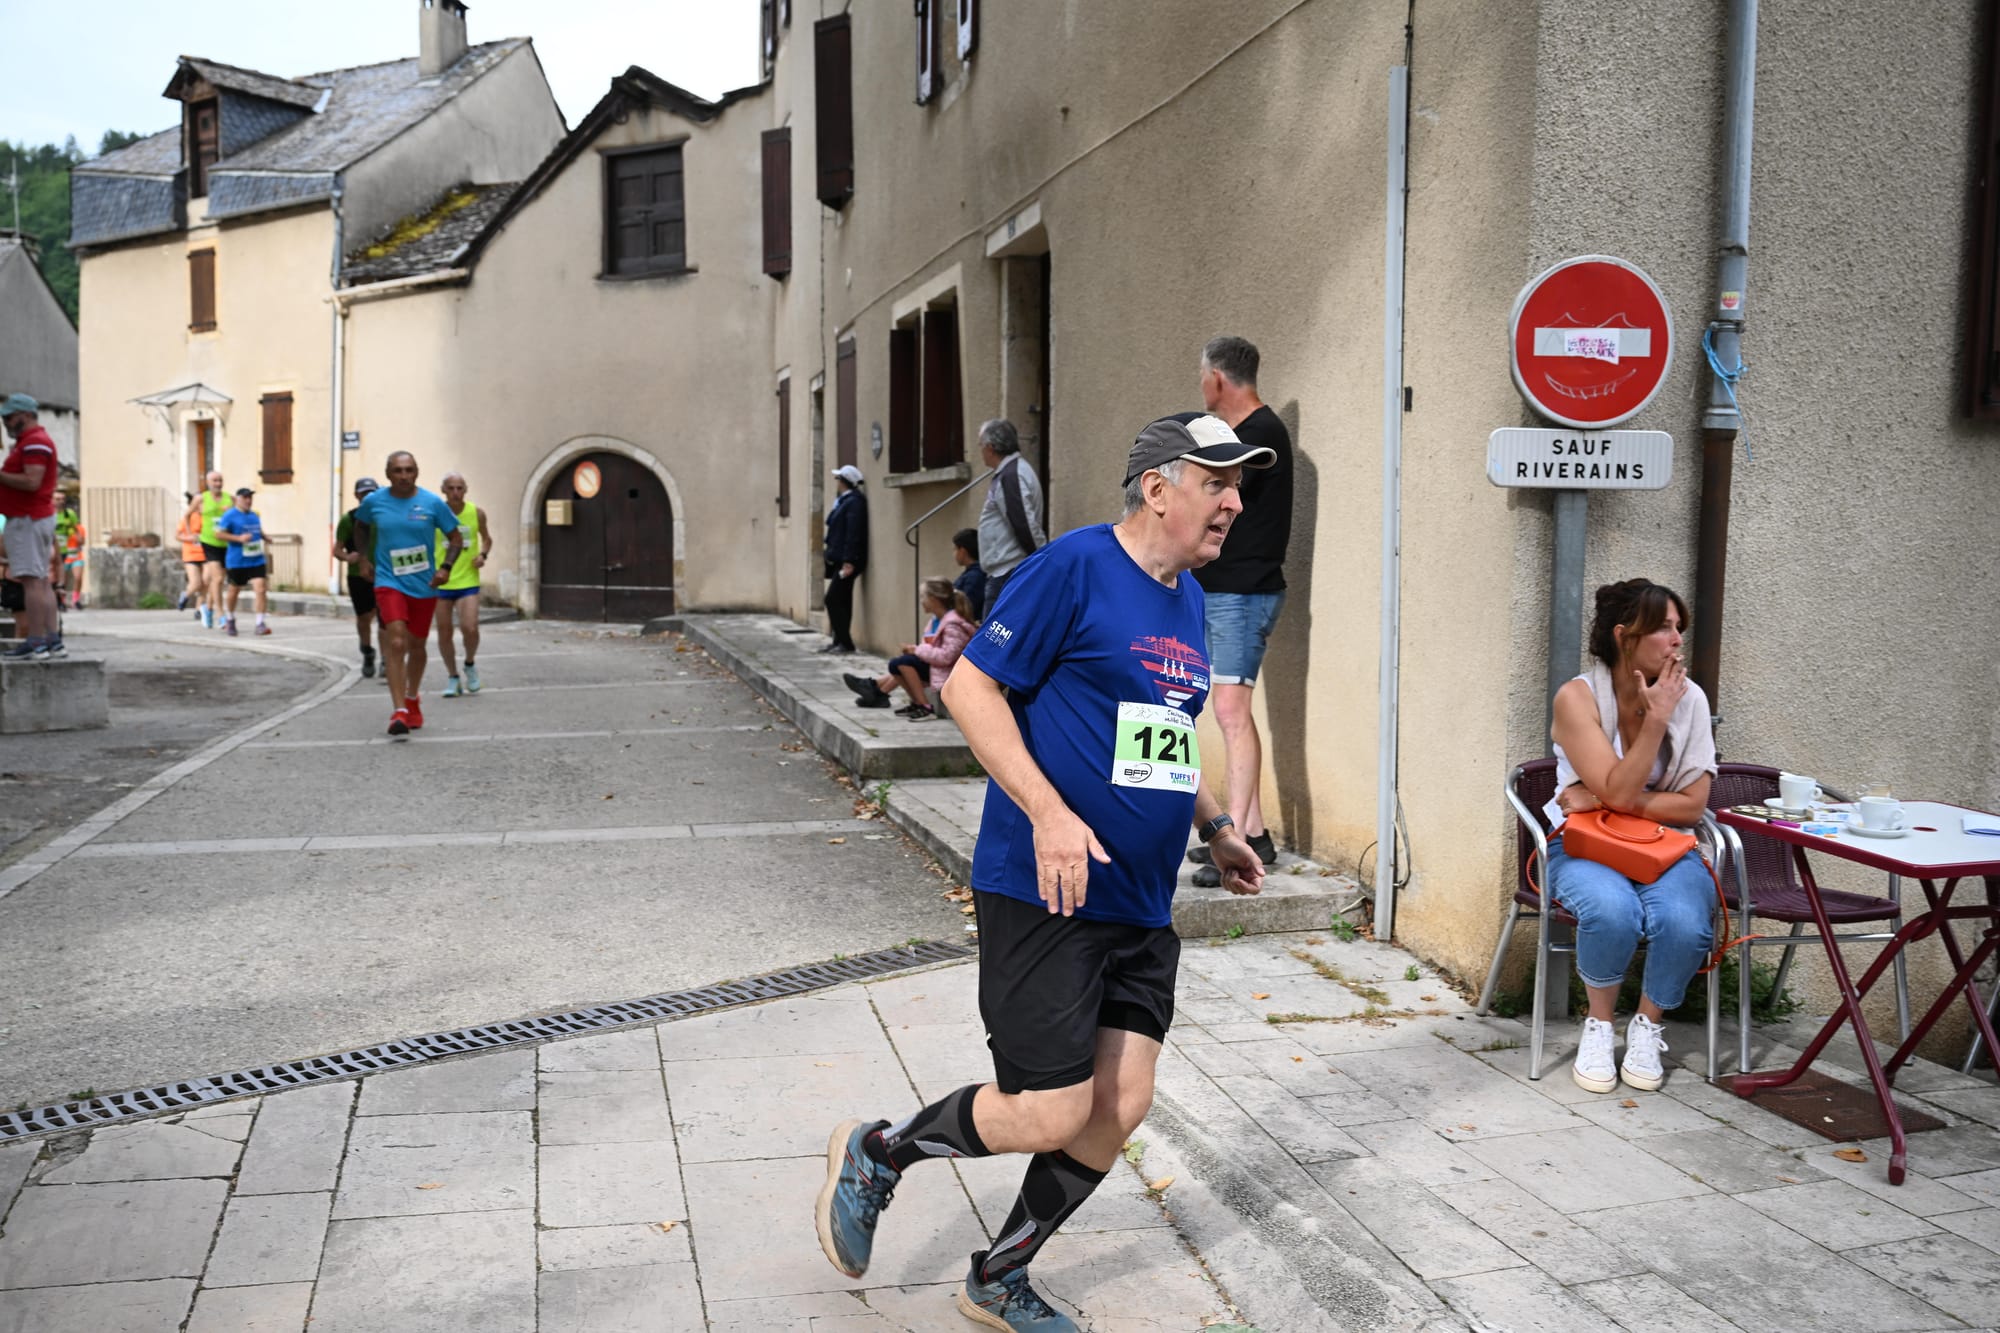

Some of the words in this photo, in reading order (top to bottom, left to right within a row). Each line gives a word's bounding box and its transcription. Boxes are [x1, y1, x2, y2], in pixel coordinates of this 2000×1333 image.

[1552, 439, 1611, 456] SAUF
[1516, 462, 1644, 479] RIVERAINS
[397, 552, 423, 567] 114
[989, 621, 1013, 640] SEMI
[1134, 726, 1190, 764] 121
